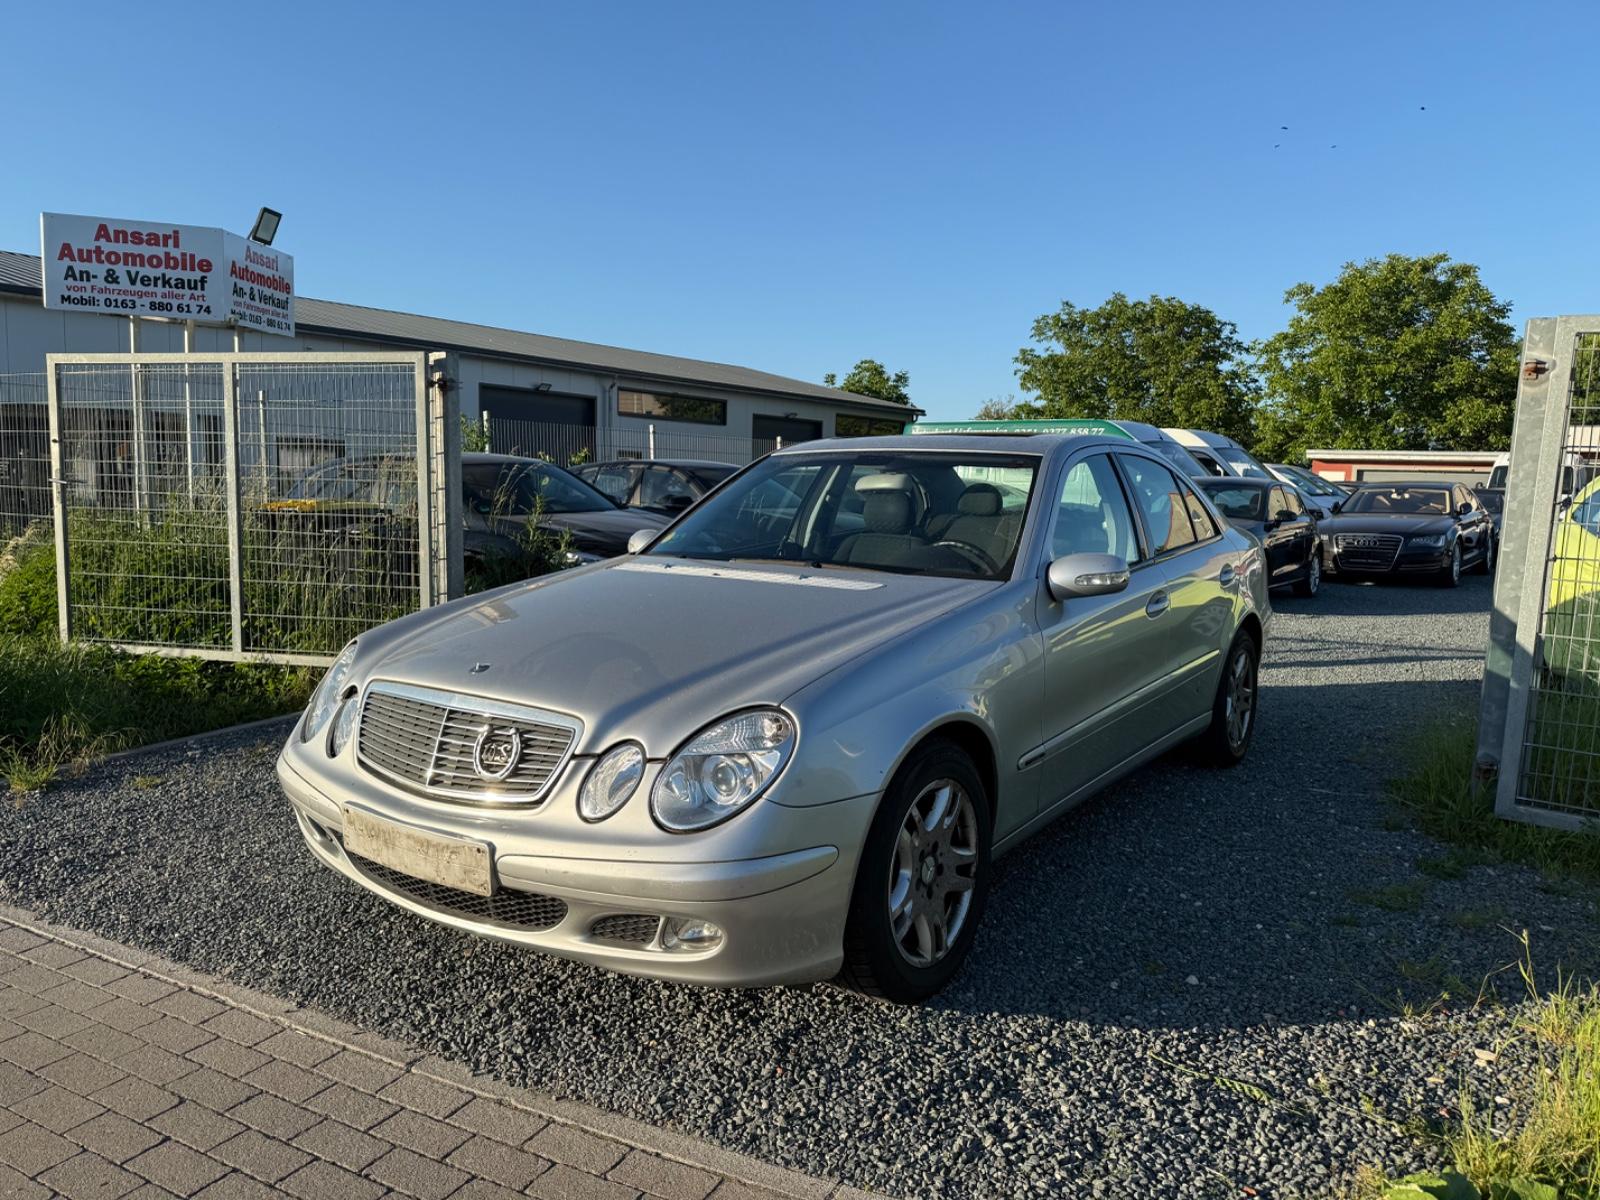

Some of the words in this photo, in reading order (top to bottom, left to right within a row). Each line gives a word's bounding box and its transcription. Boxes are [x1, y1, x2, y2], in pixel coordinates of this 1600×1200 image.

[94, 223, 180, 248] Ansari
[57, 242, 213, 273] Automobile
[245, 245, 279, 272] Ansari
[63, 265, 98, 282] An-
[103, 268, 120, 285] &
[126, 270, 208, 291] Verkauf
[230, 260, 291, 295] Automobile
[60, 294, 100, 307] Mobil:
[103, 297, 137, 309] 0163
[149, 301, 173, 312] 880
[176, 303, 193, 314] 61
[196, 305, 212, 315] 74
[65, 284, 87, 293] von
[90, 285, 158, 299] Fahrzeugen
[160, 290, 186, 300] aller
[189, 291, 206, 302] Art
[232, 281, 247, 299] An-
[249, 286, 256, 302] &
[258, 288, 289, 311] Verkauf
[231, 308, 248, 321] Mbil:
